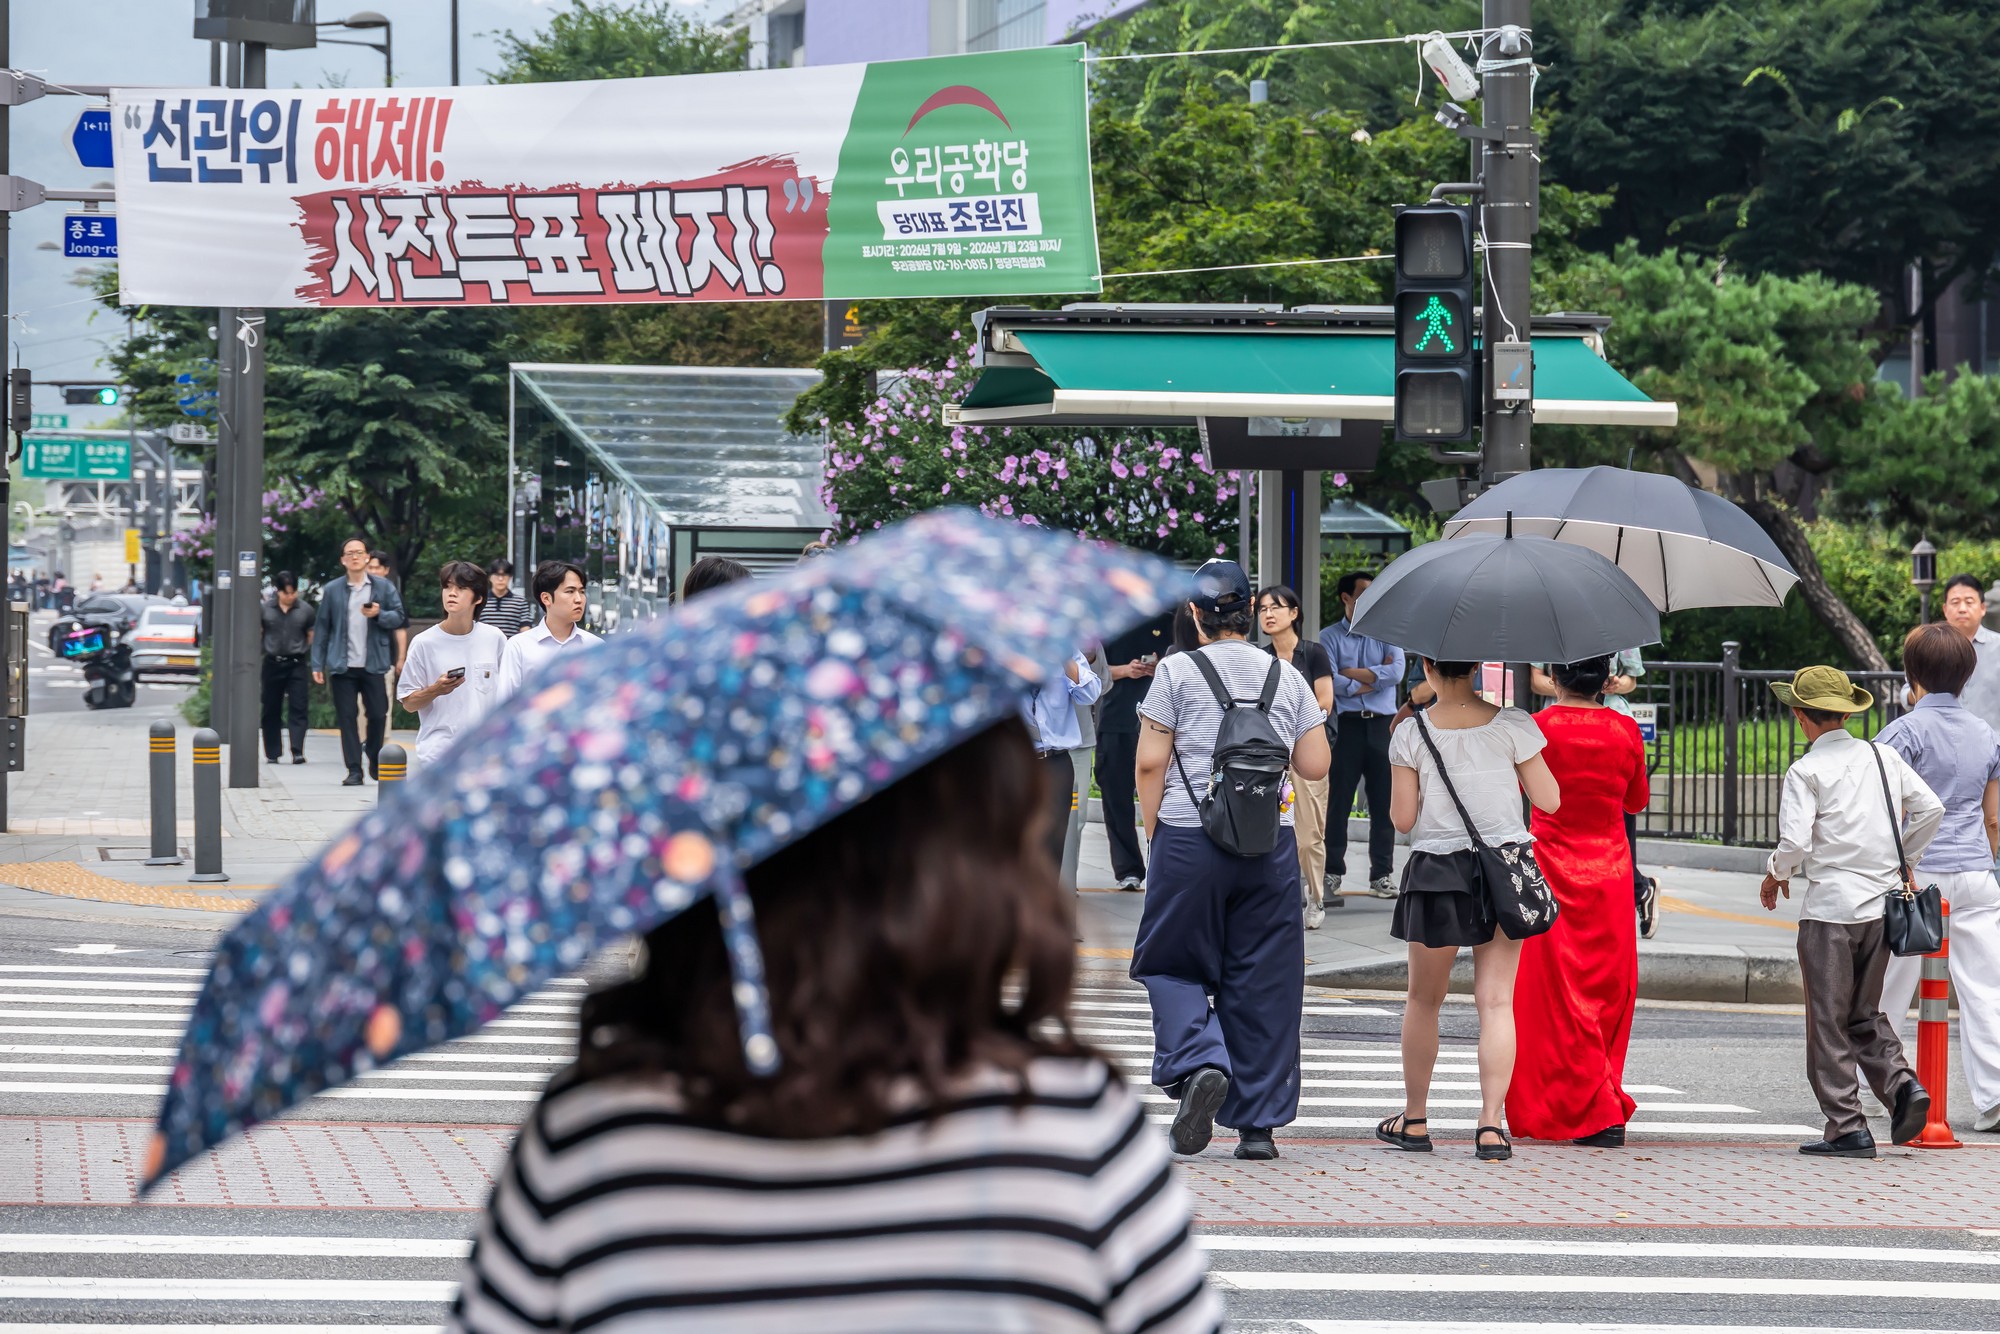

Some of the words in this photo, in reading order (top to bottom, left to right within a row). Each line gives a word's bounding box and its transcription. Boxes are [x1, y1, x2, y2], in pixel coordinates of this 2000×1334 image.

[314, 96, 454, 183] 해체!
[885, 139, 1029, 197] 우리공화당
[69, 221, 106, 239] 종로
[893, 212, 948, 234] 당대표
[949, 198, 1027, 232] 조원진
[328, 194, 604, 303] 사전투표
[891, 259, 933, 272] 우리공화당
[932, 257, 988, 271] 02-761-0815
[899, 243, 931, 256] 2026년
[931, 242, 946, 255] 7월
[947, 242, 962, 255] 9일
[969, 240, 1001, 254] 2026년
[1001, 240, 1017, 253] 7월
[1017, 239, 1039, 253] 23일
